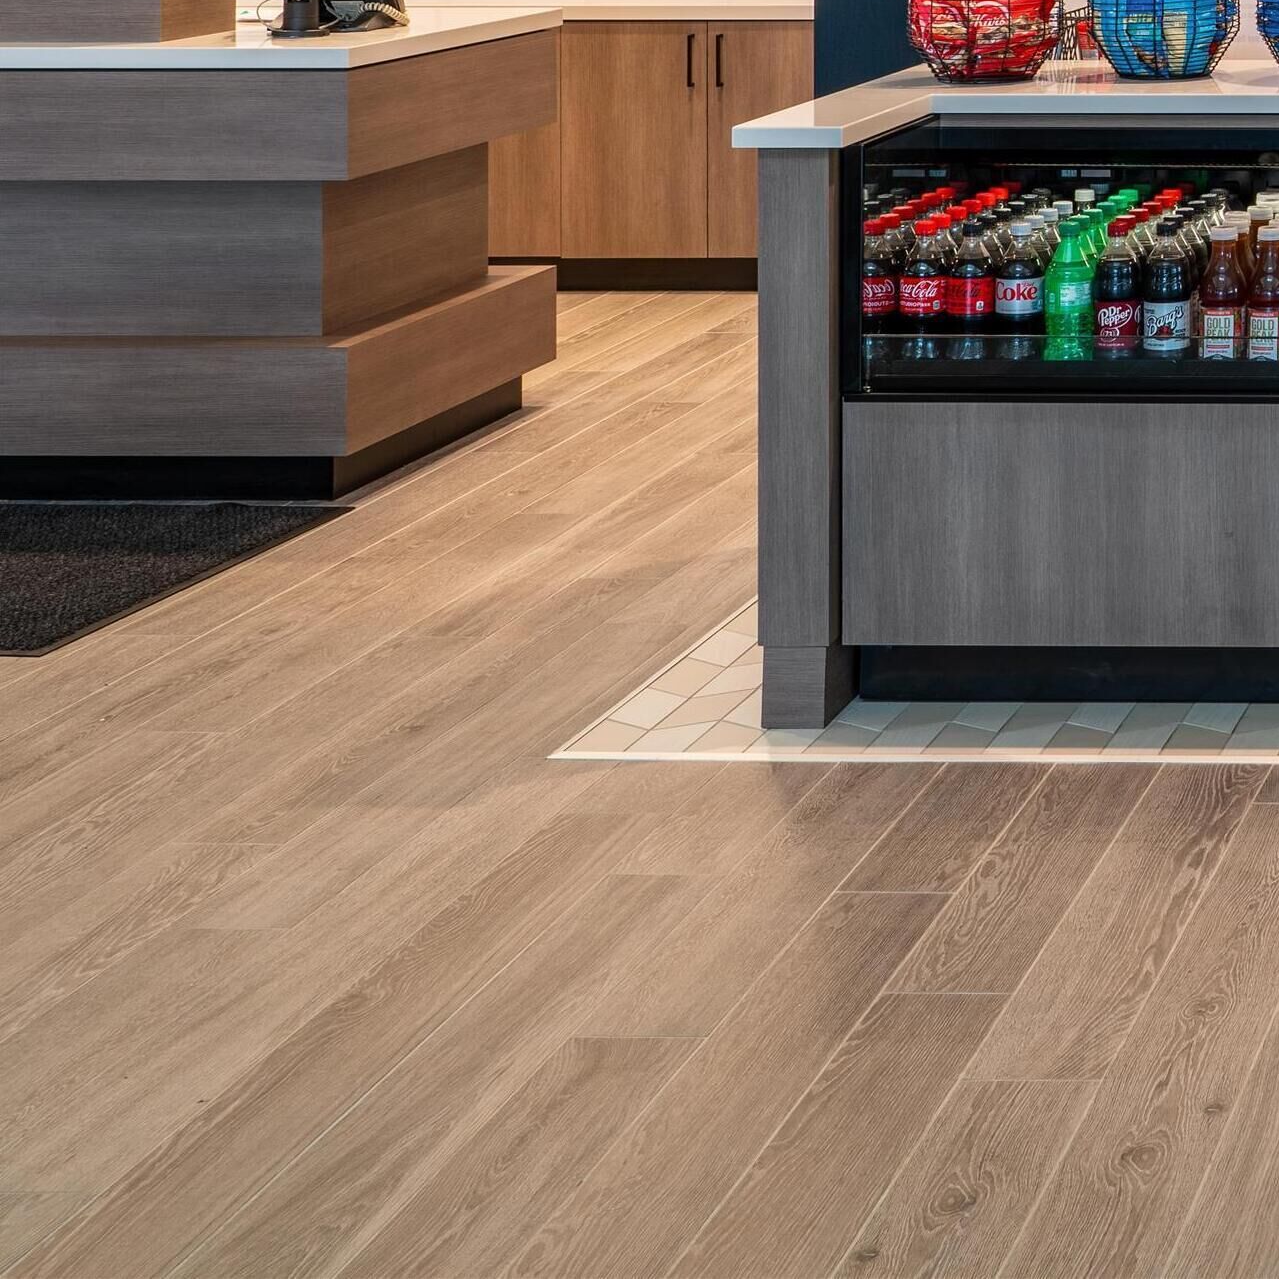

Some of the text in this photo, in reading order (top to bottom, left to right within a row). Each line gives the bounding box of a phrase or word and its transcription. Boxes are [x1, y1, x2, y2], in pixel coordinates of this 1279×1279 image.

[996, 281, 1037, 301] Coke
[1109, 305, 1122, 317] Dr
[1098, 308, 1130, 327] Pepper
[1147, 306, 1184, 336] Barq's
[1206, 317, 1230, 329] GOLD
[1251, 320, 1274, 331] GOLD
[1206, 328, 1230, 341] PEAK
[1252, 330, 1274, 342] PEAK
